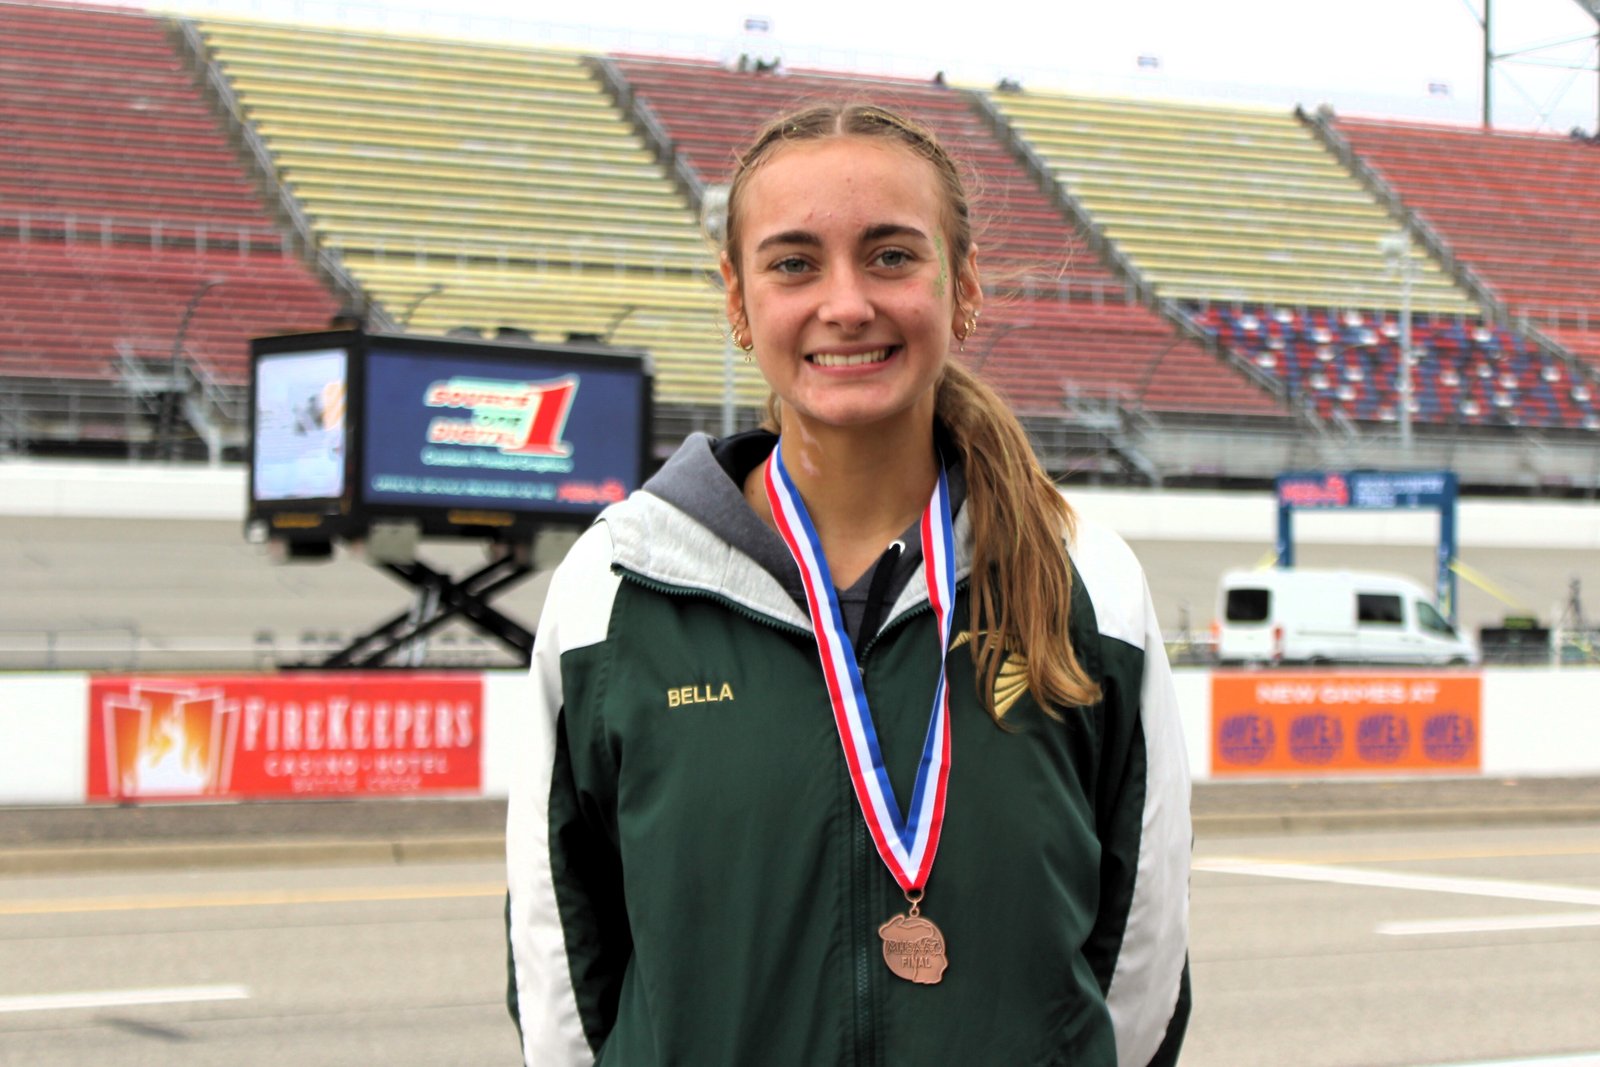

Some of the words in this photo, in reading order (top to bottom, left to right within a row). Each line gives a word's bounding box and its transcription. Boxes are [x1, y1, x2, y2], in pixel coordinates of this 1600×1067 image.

[667, 683, 734, 708] BELLA
[1255, 683, 1317, 704] NEW
[1318, 683, 1406, 704] GAMES
[1409, 683, 1440, 704] AT
[242, 695, 474, 752] FIREKEEPERS
[263, 752, 360, 778] CASINO
[373, 752, 449, 775] HOTEL
[901, 956, 932, 969] FINAL
